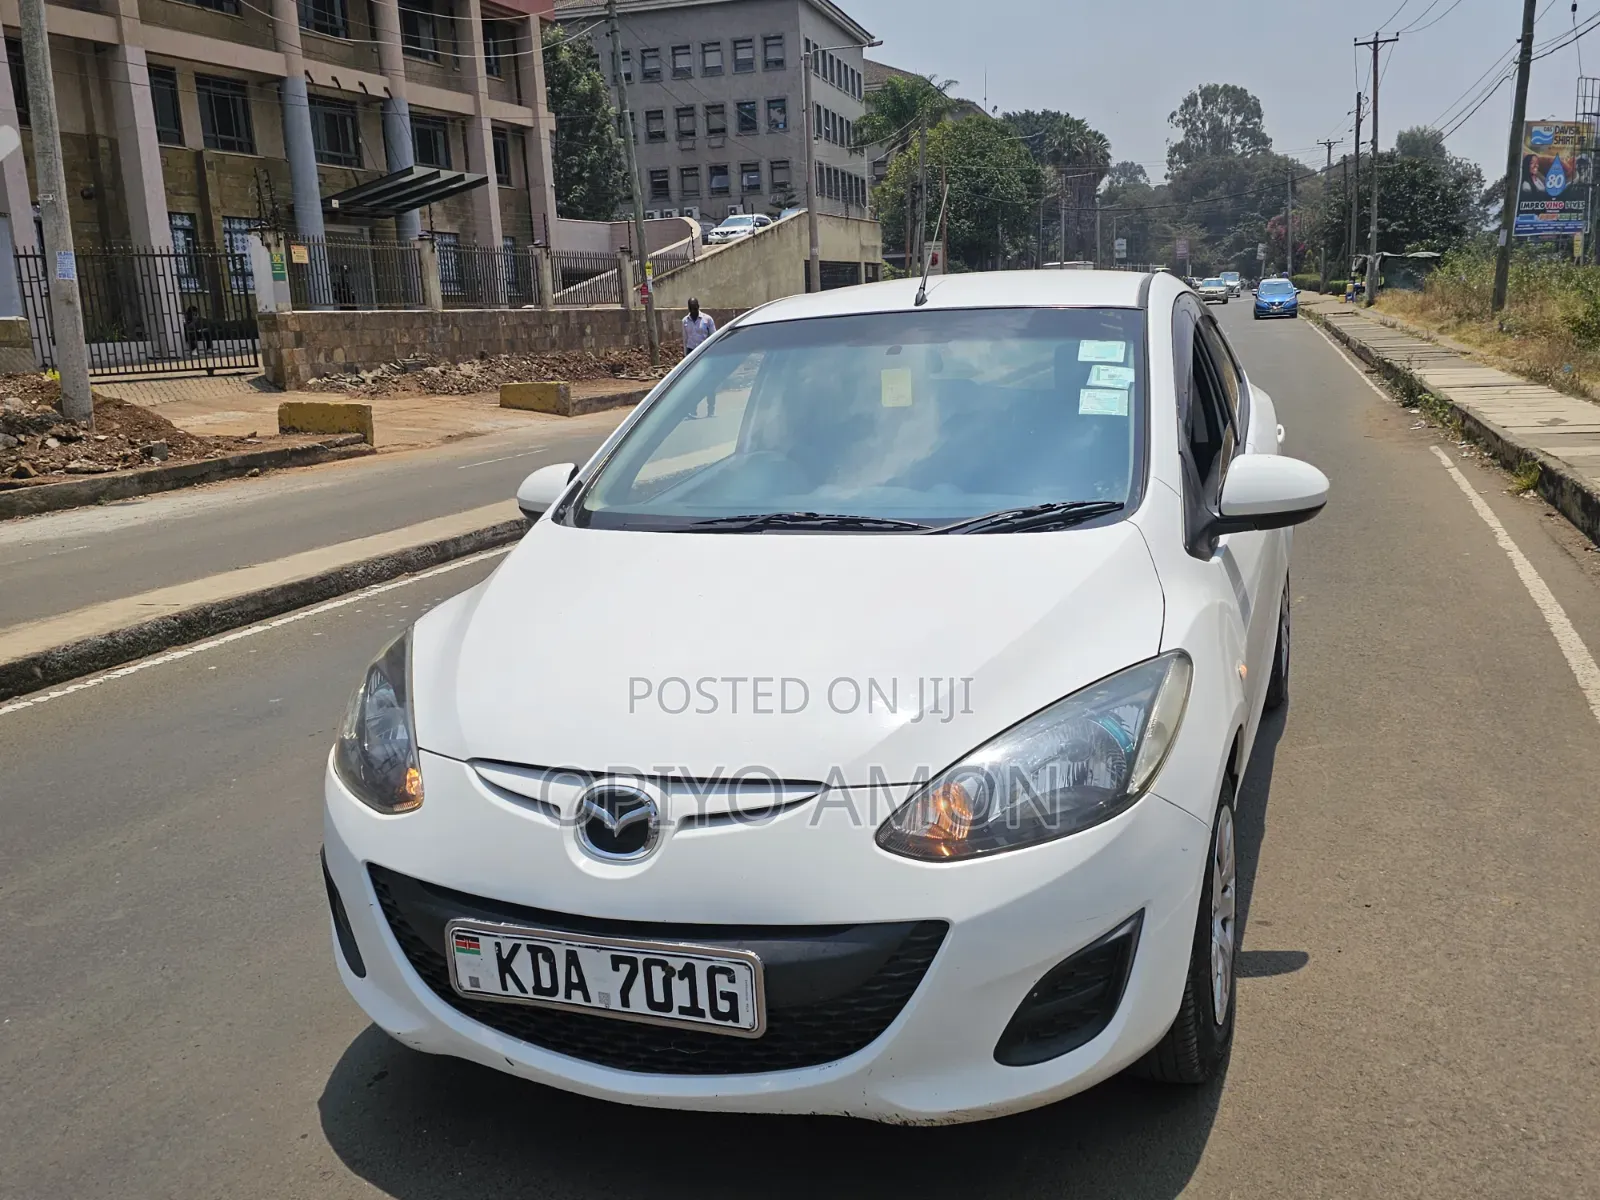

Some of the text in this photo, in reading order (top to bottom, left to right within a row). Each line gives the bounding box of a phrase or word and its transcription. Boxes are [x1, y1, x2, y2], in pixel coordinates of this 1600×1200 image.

[1554, 125, 1575, 135] DAVIS
[1546, 174, 1563, 188] 80
[1520, 201, 1564, 210] IMPROVING
[494, 941, 592, 1004] KDA
[610, 953, 741, 1025] 701G
